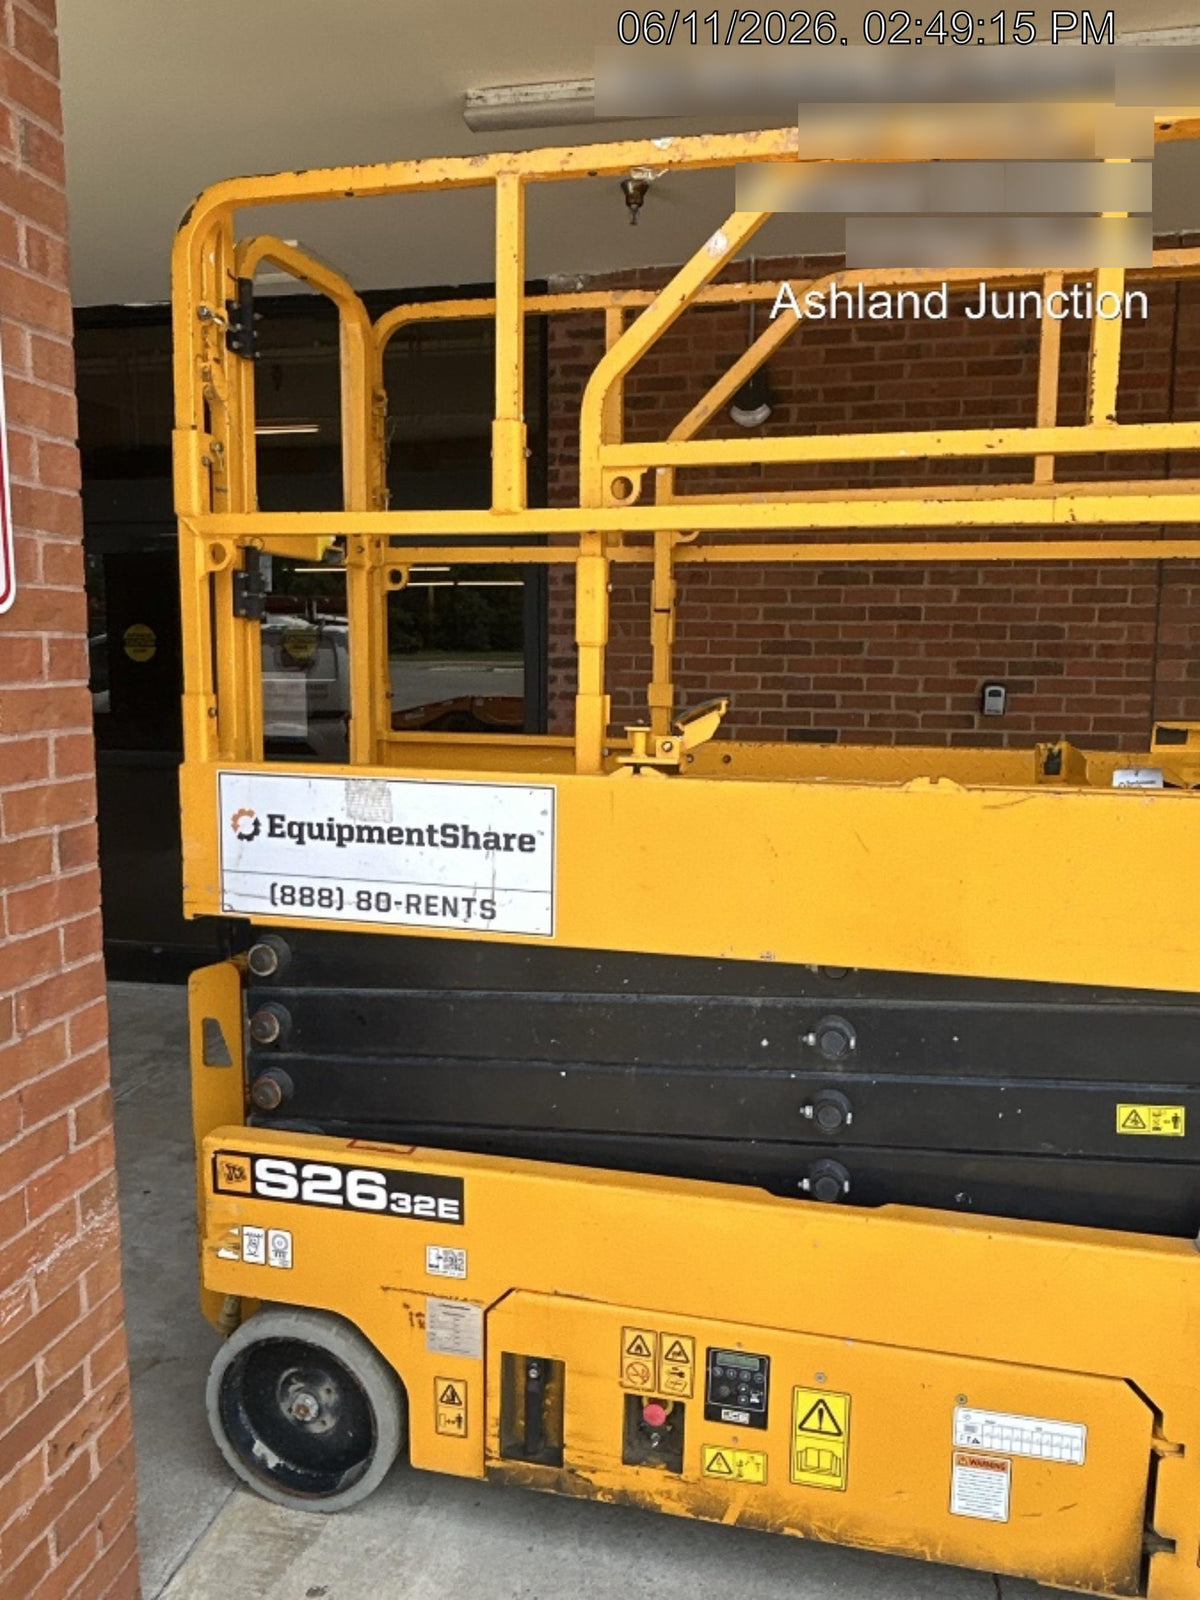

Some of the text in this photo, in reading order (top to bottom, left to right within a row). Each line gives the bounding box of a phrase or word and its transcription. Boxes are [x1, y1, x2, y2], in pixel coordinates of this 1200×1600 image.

[267, 813, 537, 853] EquipmentShare
[270, 882, 497, 922] (888) 80-RENTS
